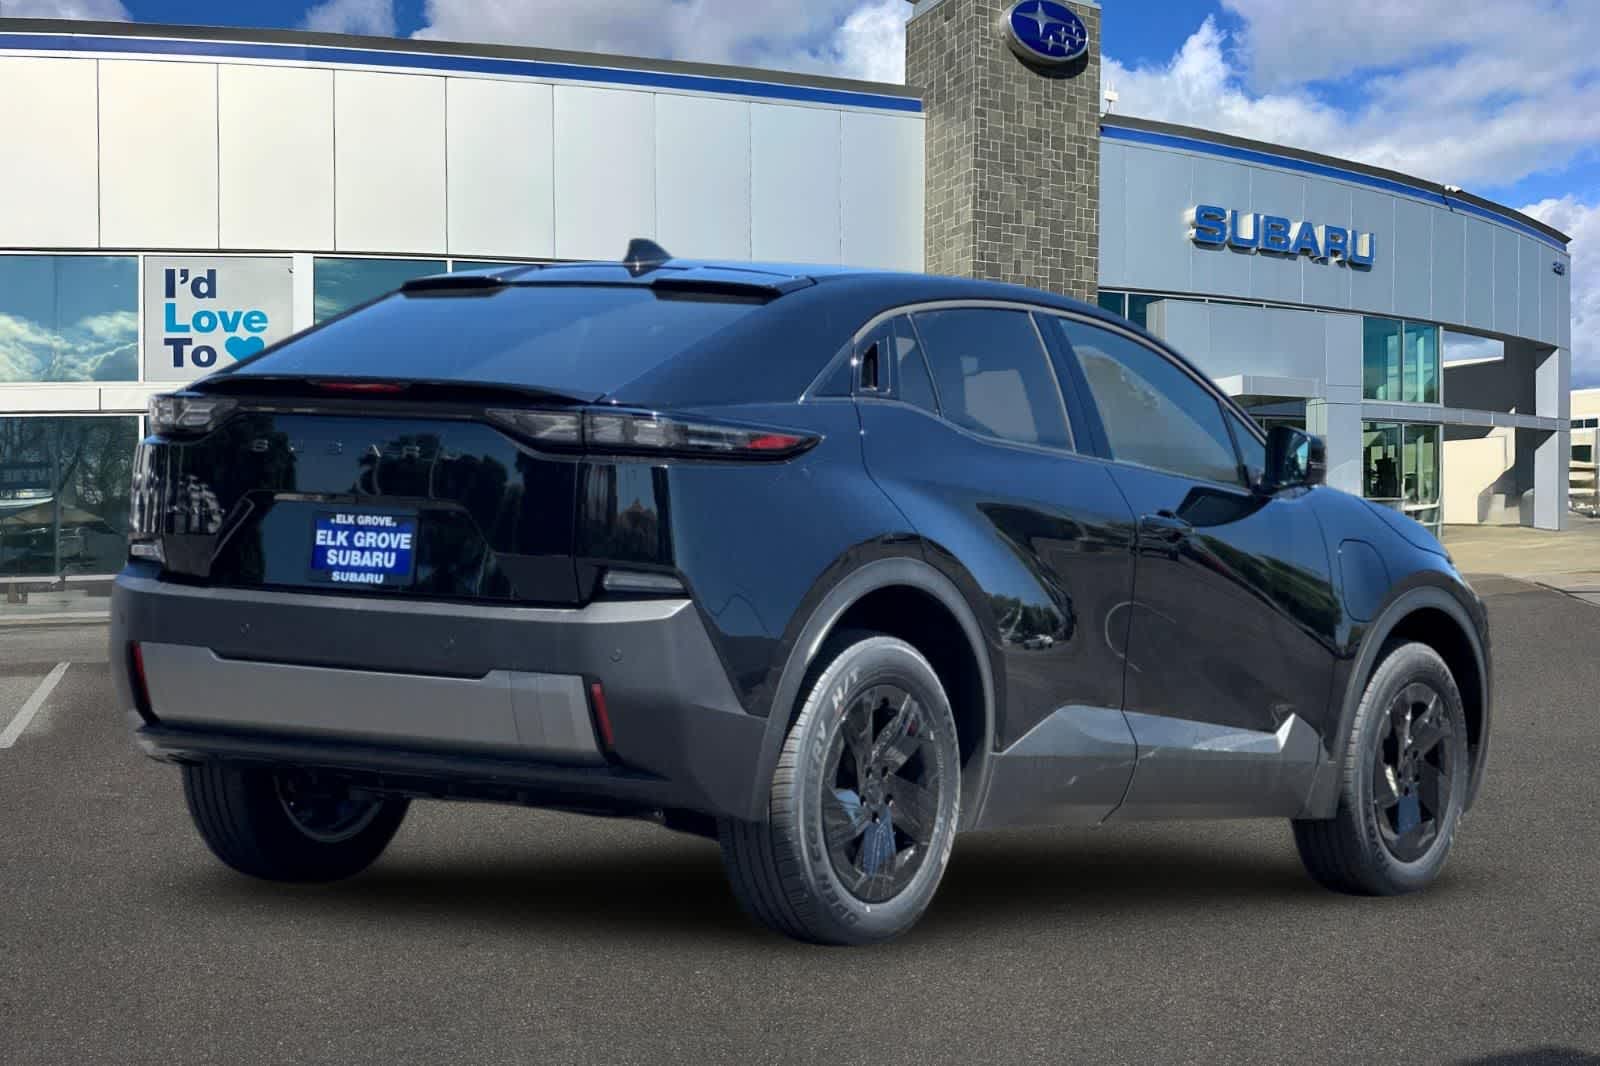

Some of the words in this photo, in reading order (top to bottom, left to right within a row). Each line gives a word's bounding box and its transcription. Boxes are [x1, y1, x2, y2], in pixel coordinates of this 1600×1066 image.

[1191, 204, 1376, 268] SUBARU
[165, 302, 269, 333] Love
[164, 337, 217, 368] To
[357, 515, 393, 527] GROVE
[315, 529, 350, 547] ELK
[353, 531, 412, 550] GROVE
[326, 549, 397, 568] SUBARU
[331, 571, 384, 584] SUBARU
